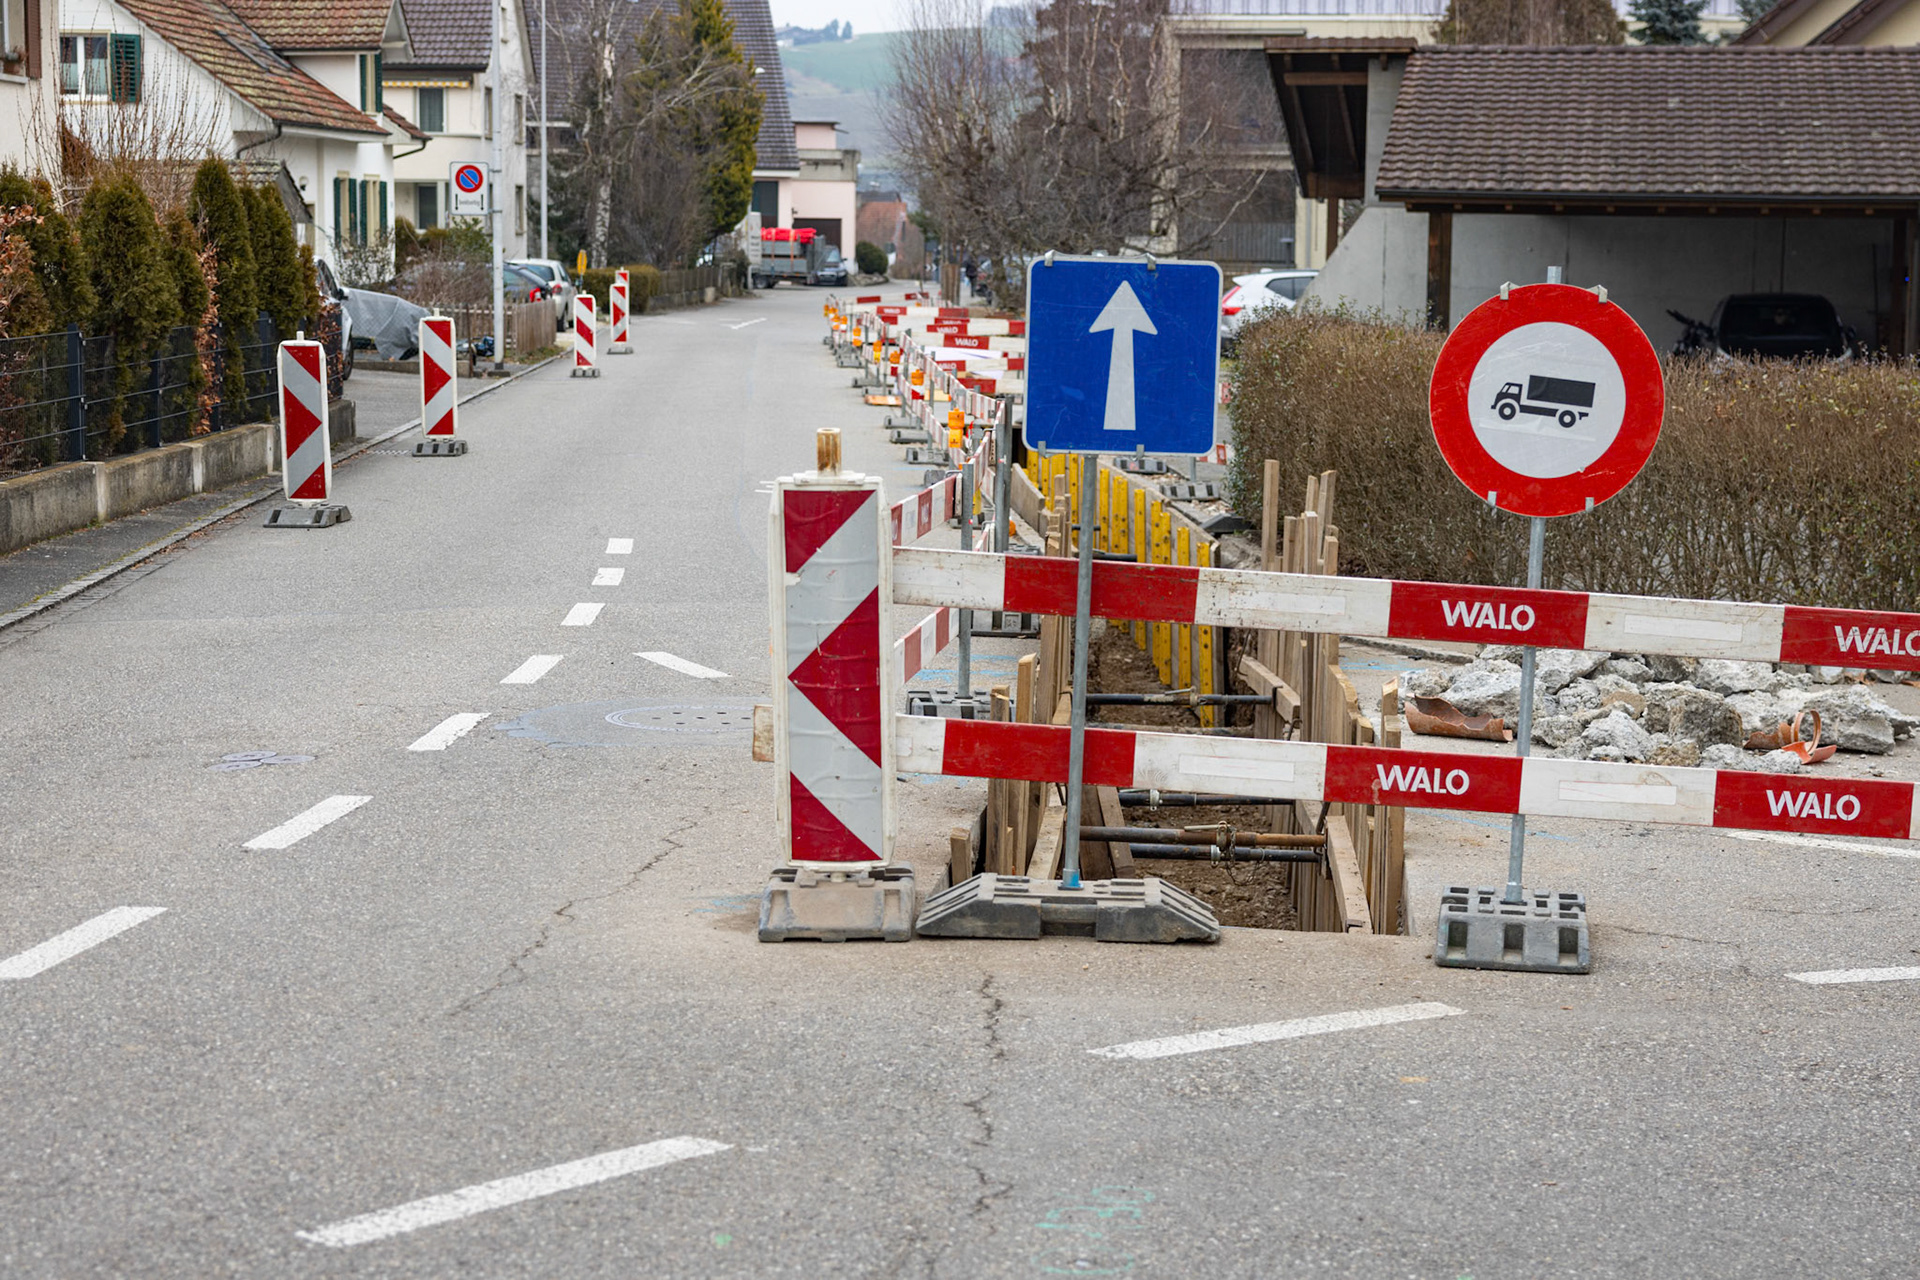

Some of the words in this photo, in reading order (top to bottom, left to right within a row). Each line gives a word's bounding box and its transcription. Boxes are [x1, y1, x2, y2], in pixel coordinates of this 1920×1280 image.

[955, 338, 978, 347] WALO
[1441, 600, 1535, 631] WALO
[1376, 764, 1470, 796] WALO
[1766, 789, 1861, 821] WALO
